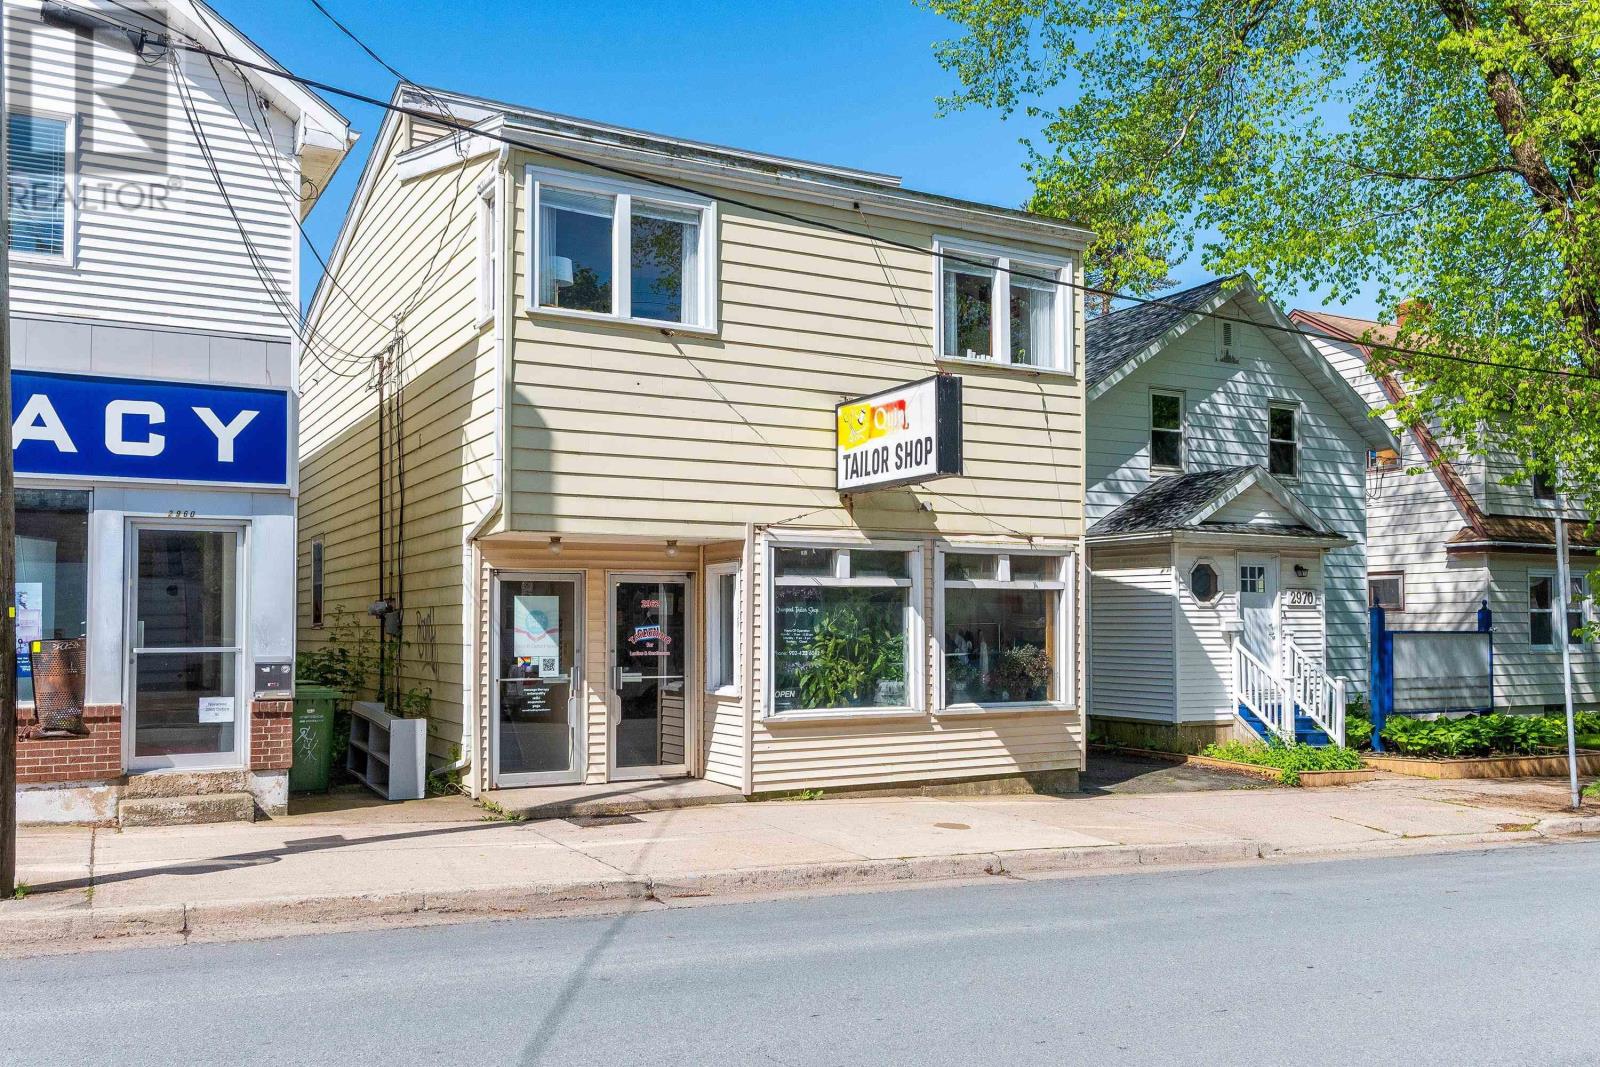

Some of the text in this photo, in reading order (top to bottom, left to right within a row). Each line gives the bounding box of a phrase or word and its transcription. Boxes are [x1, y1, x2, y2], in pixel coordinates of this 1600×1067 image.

[843, 437, 933, 480] TAILOR SHOP
[168, 510, 196, 519] 2960
[1290, 591, 1314, 605] 2970
[775, 690, 796, 698] OPEN
